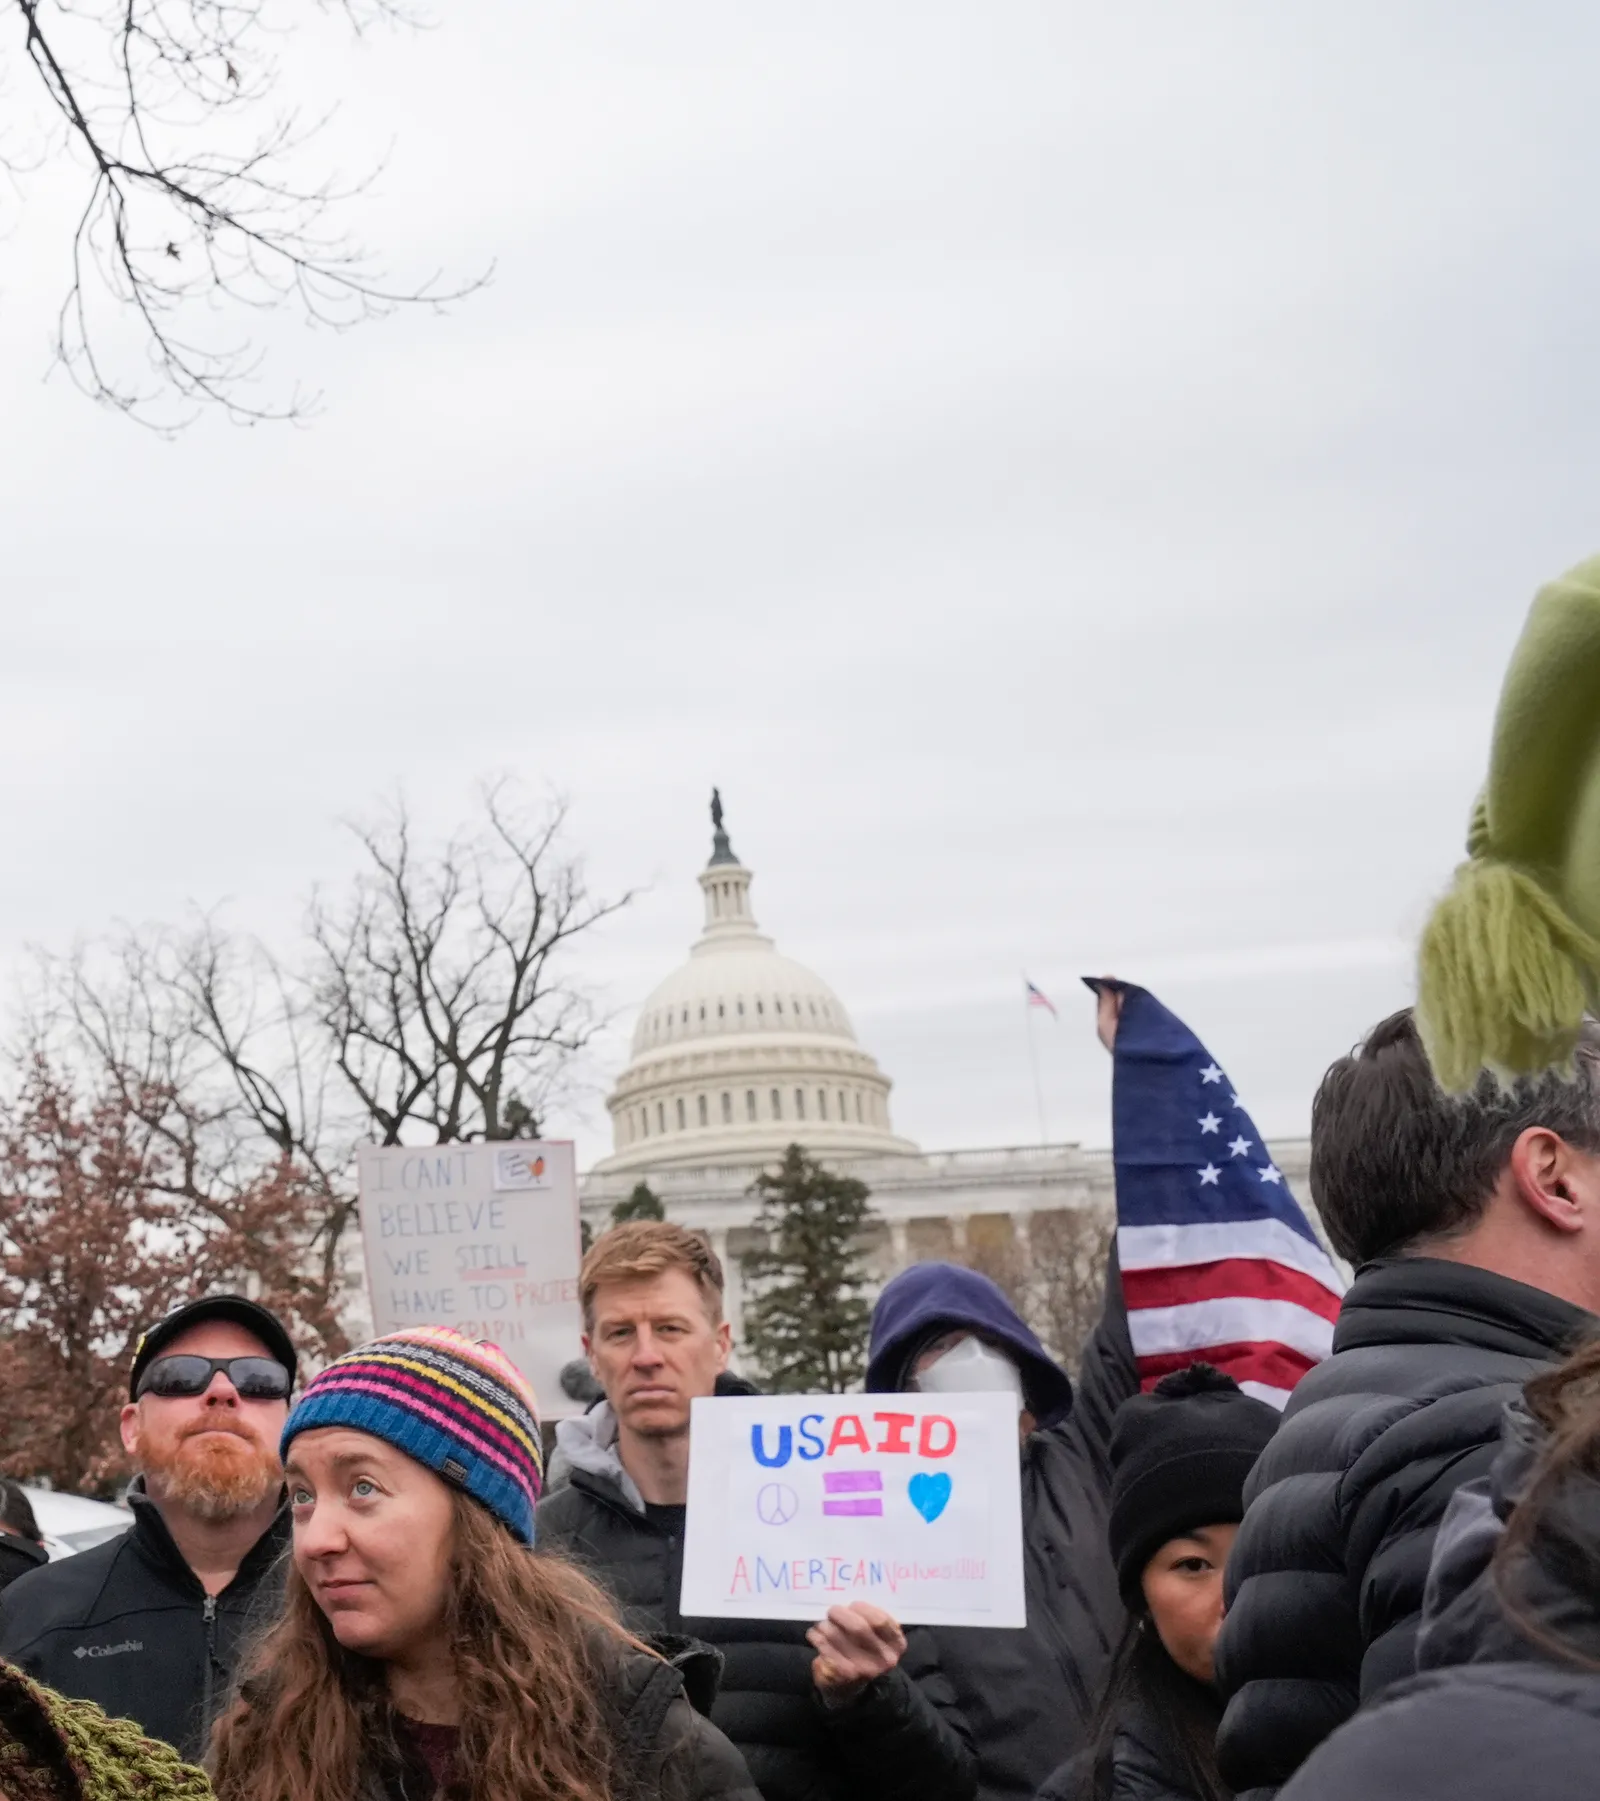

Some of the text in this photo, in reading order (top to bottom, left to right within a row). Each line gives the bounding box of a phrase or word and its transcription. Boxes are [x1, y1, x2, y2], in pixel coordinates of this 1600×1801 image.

[370, 1156, 393, 1192] I
[378, 1198, 506, 1238] BELIEVE
[383, 1244, 528, 1276] WE STILL
[390, 1287, 455, 1314] HAVE
[468, 1284, 507, 1311] TO
[751, 1412, 957, 1468] USAID
[730, 1556, 881, 1595] AMERICAN
[87, 1640, 143, 1657] Columbia
